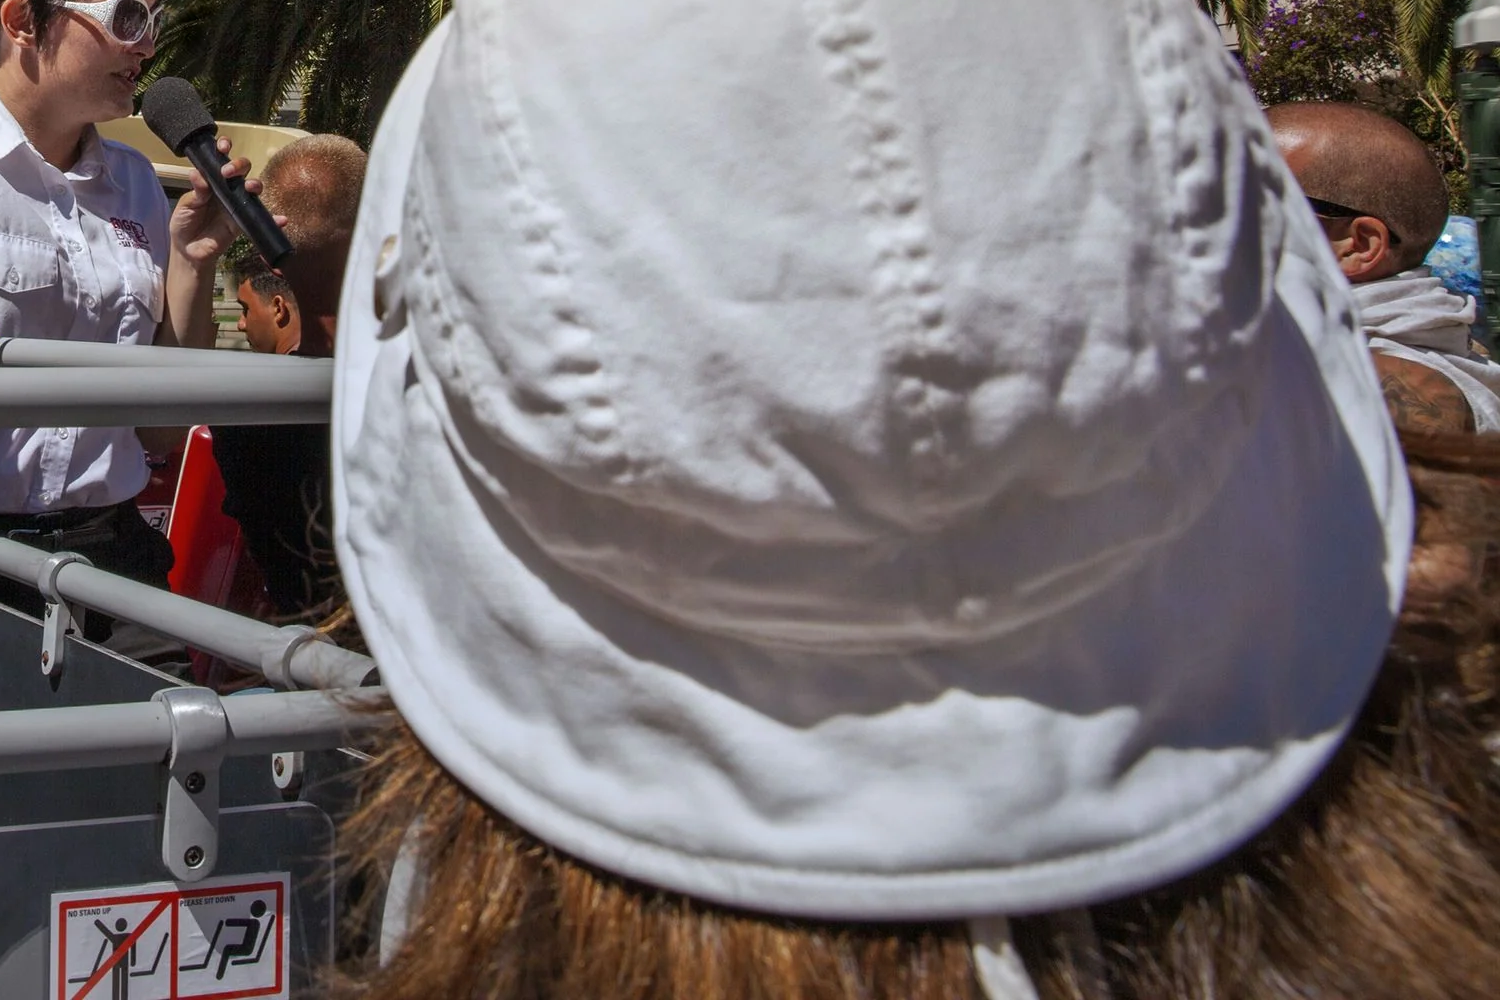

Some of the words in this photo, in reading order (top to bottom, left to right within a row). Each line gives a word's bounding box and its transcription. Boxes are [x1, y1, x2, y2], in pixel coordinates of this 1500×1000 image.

[179, 897, 203, 907] PLEASE
[204, 897, 214, 905] SIT
[215, 895, 236, 904] DOWN
[68, 910, 78, 918] NO
[79, 908, 101, 917] STAND
[102, 907, 112, 915] UP
